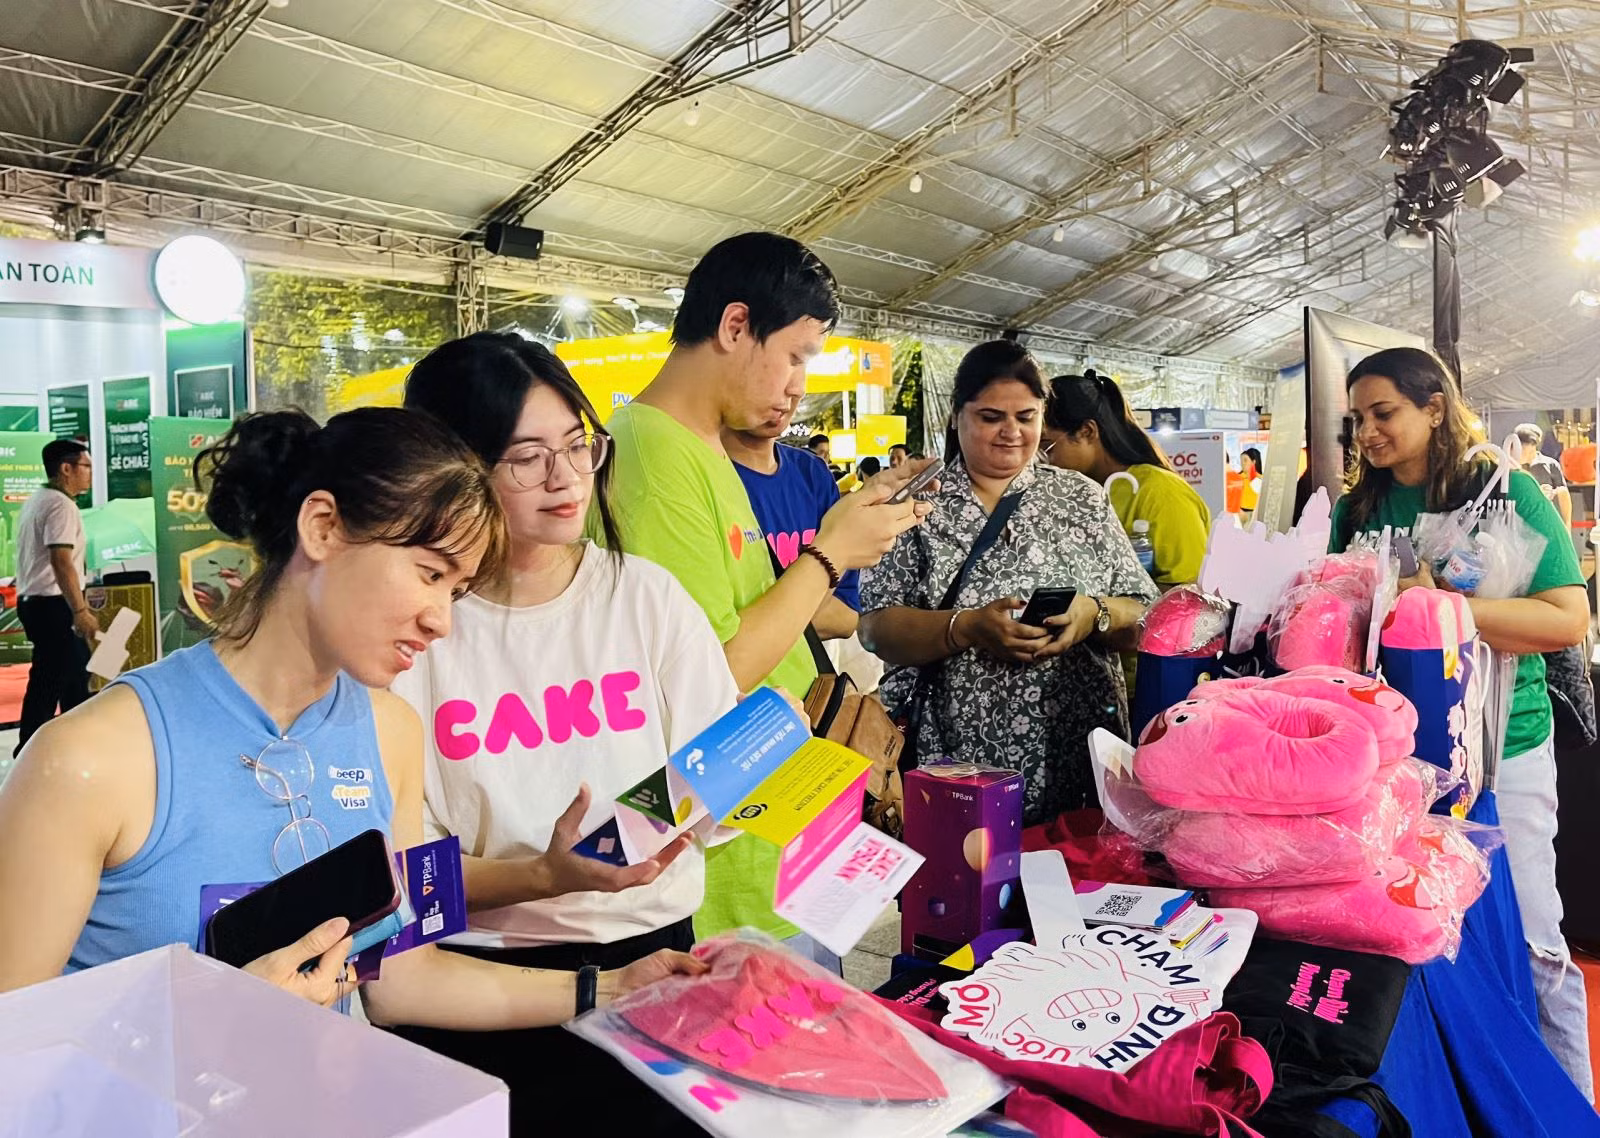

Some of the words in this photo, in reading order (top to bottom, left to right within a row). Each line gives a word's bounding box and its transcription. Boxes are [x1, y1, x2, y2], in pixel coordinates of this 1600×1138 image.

[0, 262, 22, 281] N
[1168, 451, 1198, 467] ỐC
[434, 671, 646, 761] CAKE
[341, 798, 366, 808] Visa
[952, 792, 974, 802] TPBank
[422, 854, 432, 885] TPBank
[1096, 929, 1200, 986] CHẠM
[949, 983, 990, 1028] MƠ
[1002, 1032, 1071, 1063] ƯỚC
